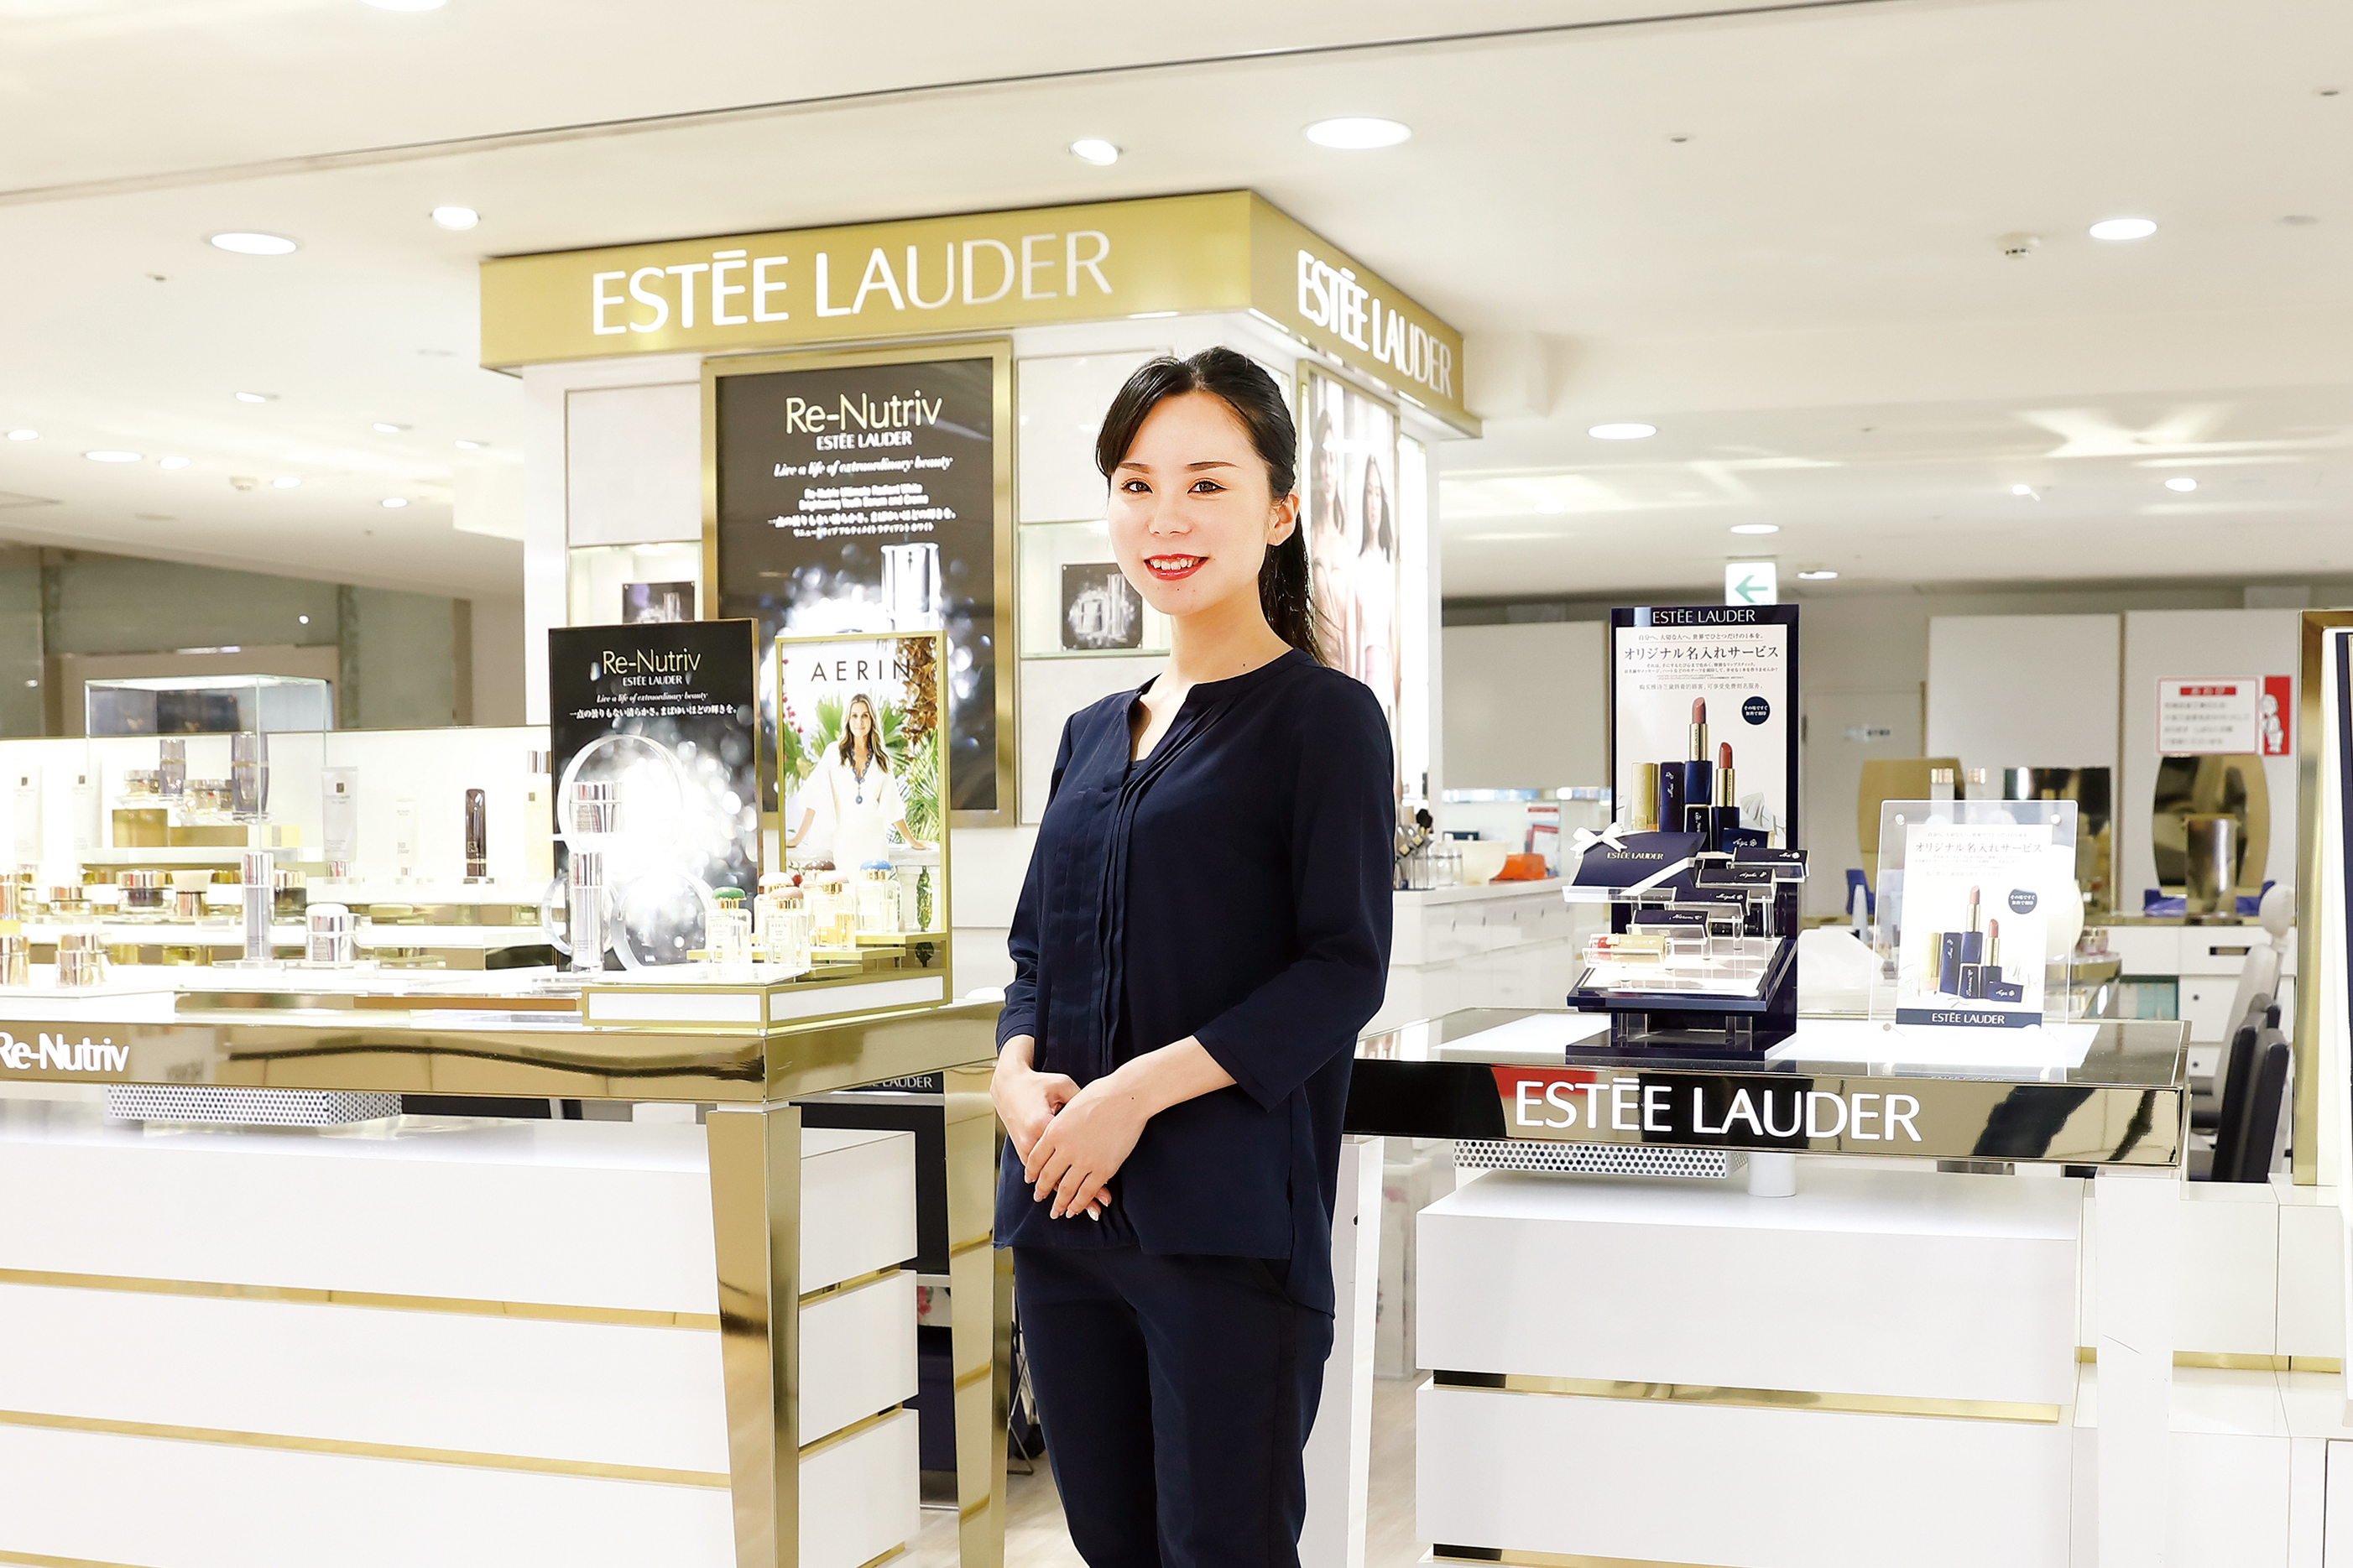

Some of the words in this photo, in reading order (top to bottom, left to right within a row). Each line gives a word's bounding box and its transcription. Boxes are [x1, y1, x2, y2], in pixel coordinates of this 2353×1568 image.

[815, 229, 1114, 318] LAUDER
[1372, 298, 1453, 399] LAUDER
[785, 389, 942, 434] Re-Nutriv
[858, 430, 913, 449] LAUDER
[774, 463, 797, 477] Live
[798, 466, 806, 477] a
[808, 461, 826, 478] life
[826, 460, 841, 477] of
[914, 456, 954, 471] beauty
[1698, 609, 1756, 623] LAUDER
[602, 648, 702, 675] Re-Nutriv
[1624, 646, 1779, 661] オリジナル名入れサービス
[648, 674, 682, 685] LAUDER
[811, 659, 910, 682] AERIN
[597, 694, 610, 703] Live
[618, 692, 629, 704] life
[629, 692, 637, 704] of
[637, 691, 684, 702] extraordinary
[684, 690, 708, 701] beauty
[1631, 852, 1664, 861] LAUDER
[1916, 842, 2043, 853] オリジナル名入れサービス
[1964, 1014, 2005, 1024] LAUDER
[1693, 1086, 1923, 1142] LAUDER
